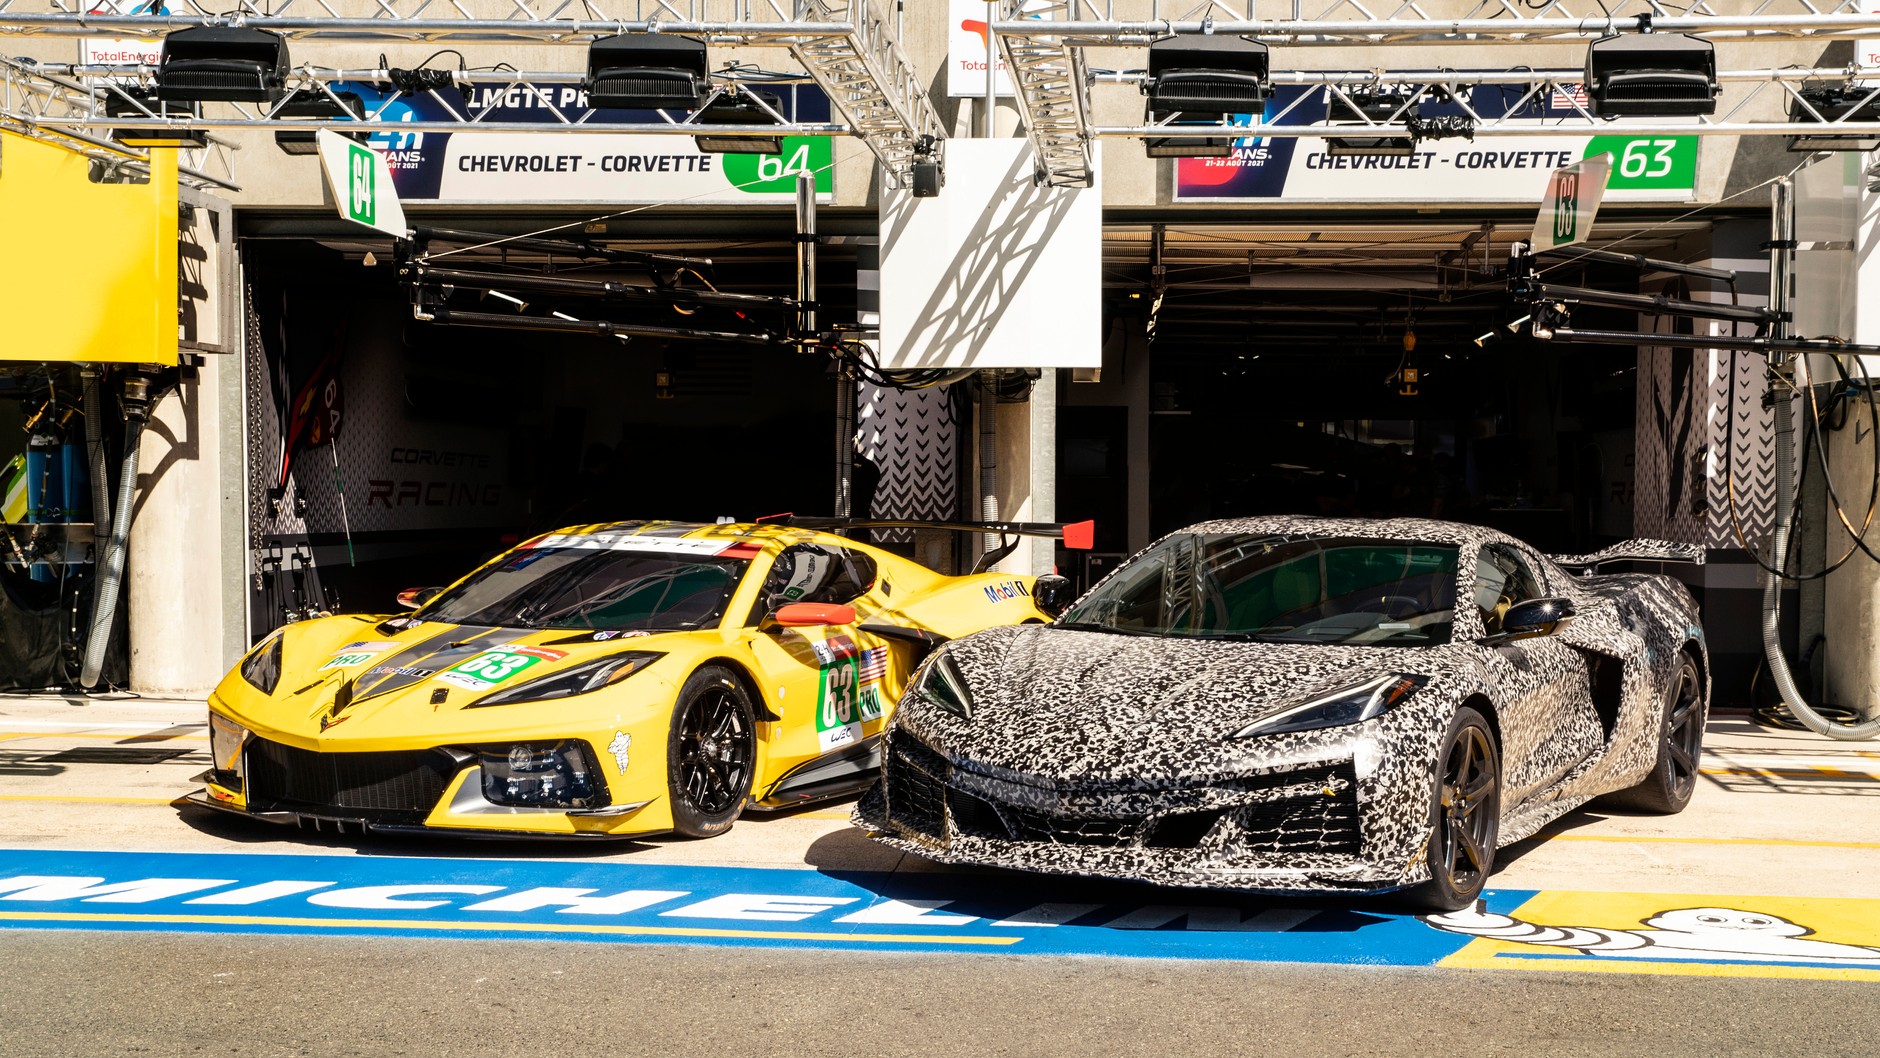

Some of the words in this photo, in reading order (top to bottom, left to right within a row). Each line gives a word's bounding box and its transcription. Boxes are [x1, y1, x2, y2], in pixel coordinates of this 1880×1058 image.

[91, 51, 162, 64] TotalEnergi
[468, 88, 557, 108] LMGTE
[458, 155, 582, 172] CHEVROLET
[600, 155, 712, 172] CORVETTE
[758, 145, 810, 181] 64
[1226, 158, 1246, 167] AOÛT
[1306, 152, 1436, 169] CHEVROLET
[1455, 151, 1571, 169] CORVETTE
[1620, 139, 1677, 178] 63
[353, 152, 372, 218] 64
[1557, 174, 1575, 238] 63
[391, 447, 490, 468] CORVETTE
[368, 479, 502, 508] RACING
[984, 581, 1020, 603] Mobil
[323, 654, 372, 669] PRO
[458, 653, 529, 679] 63
[823, 663, 853, 728] 63
[860, 687, 881, 717] PRO
[831, 727, 851, 742] WEC
[0, 875, 1326, 932] MICHELIN
